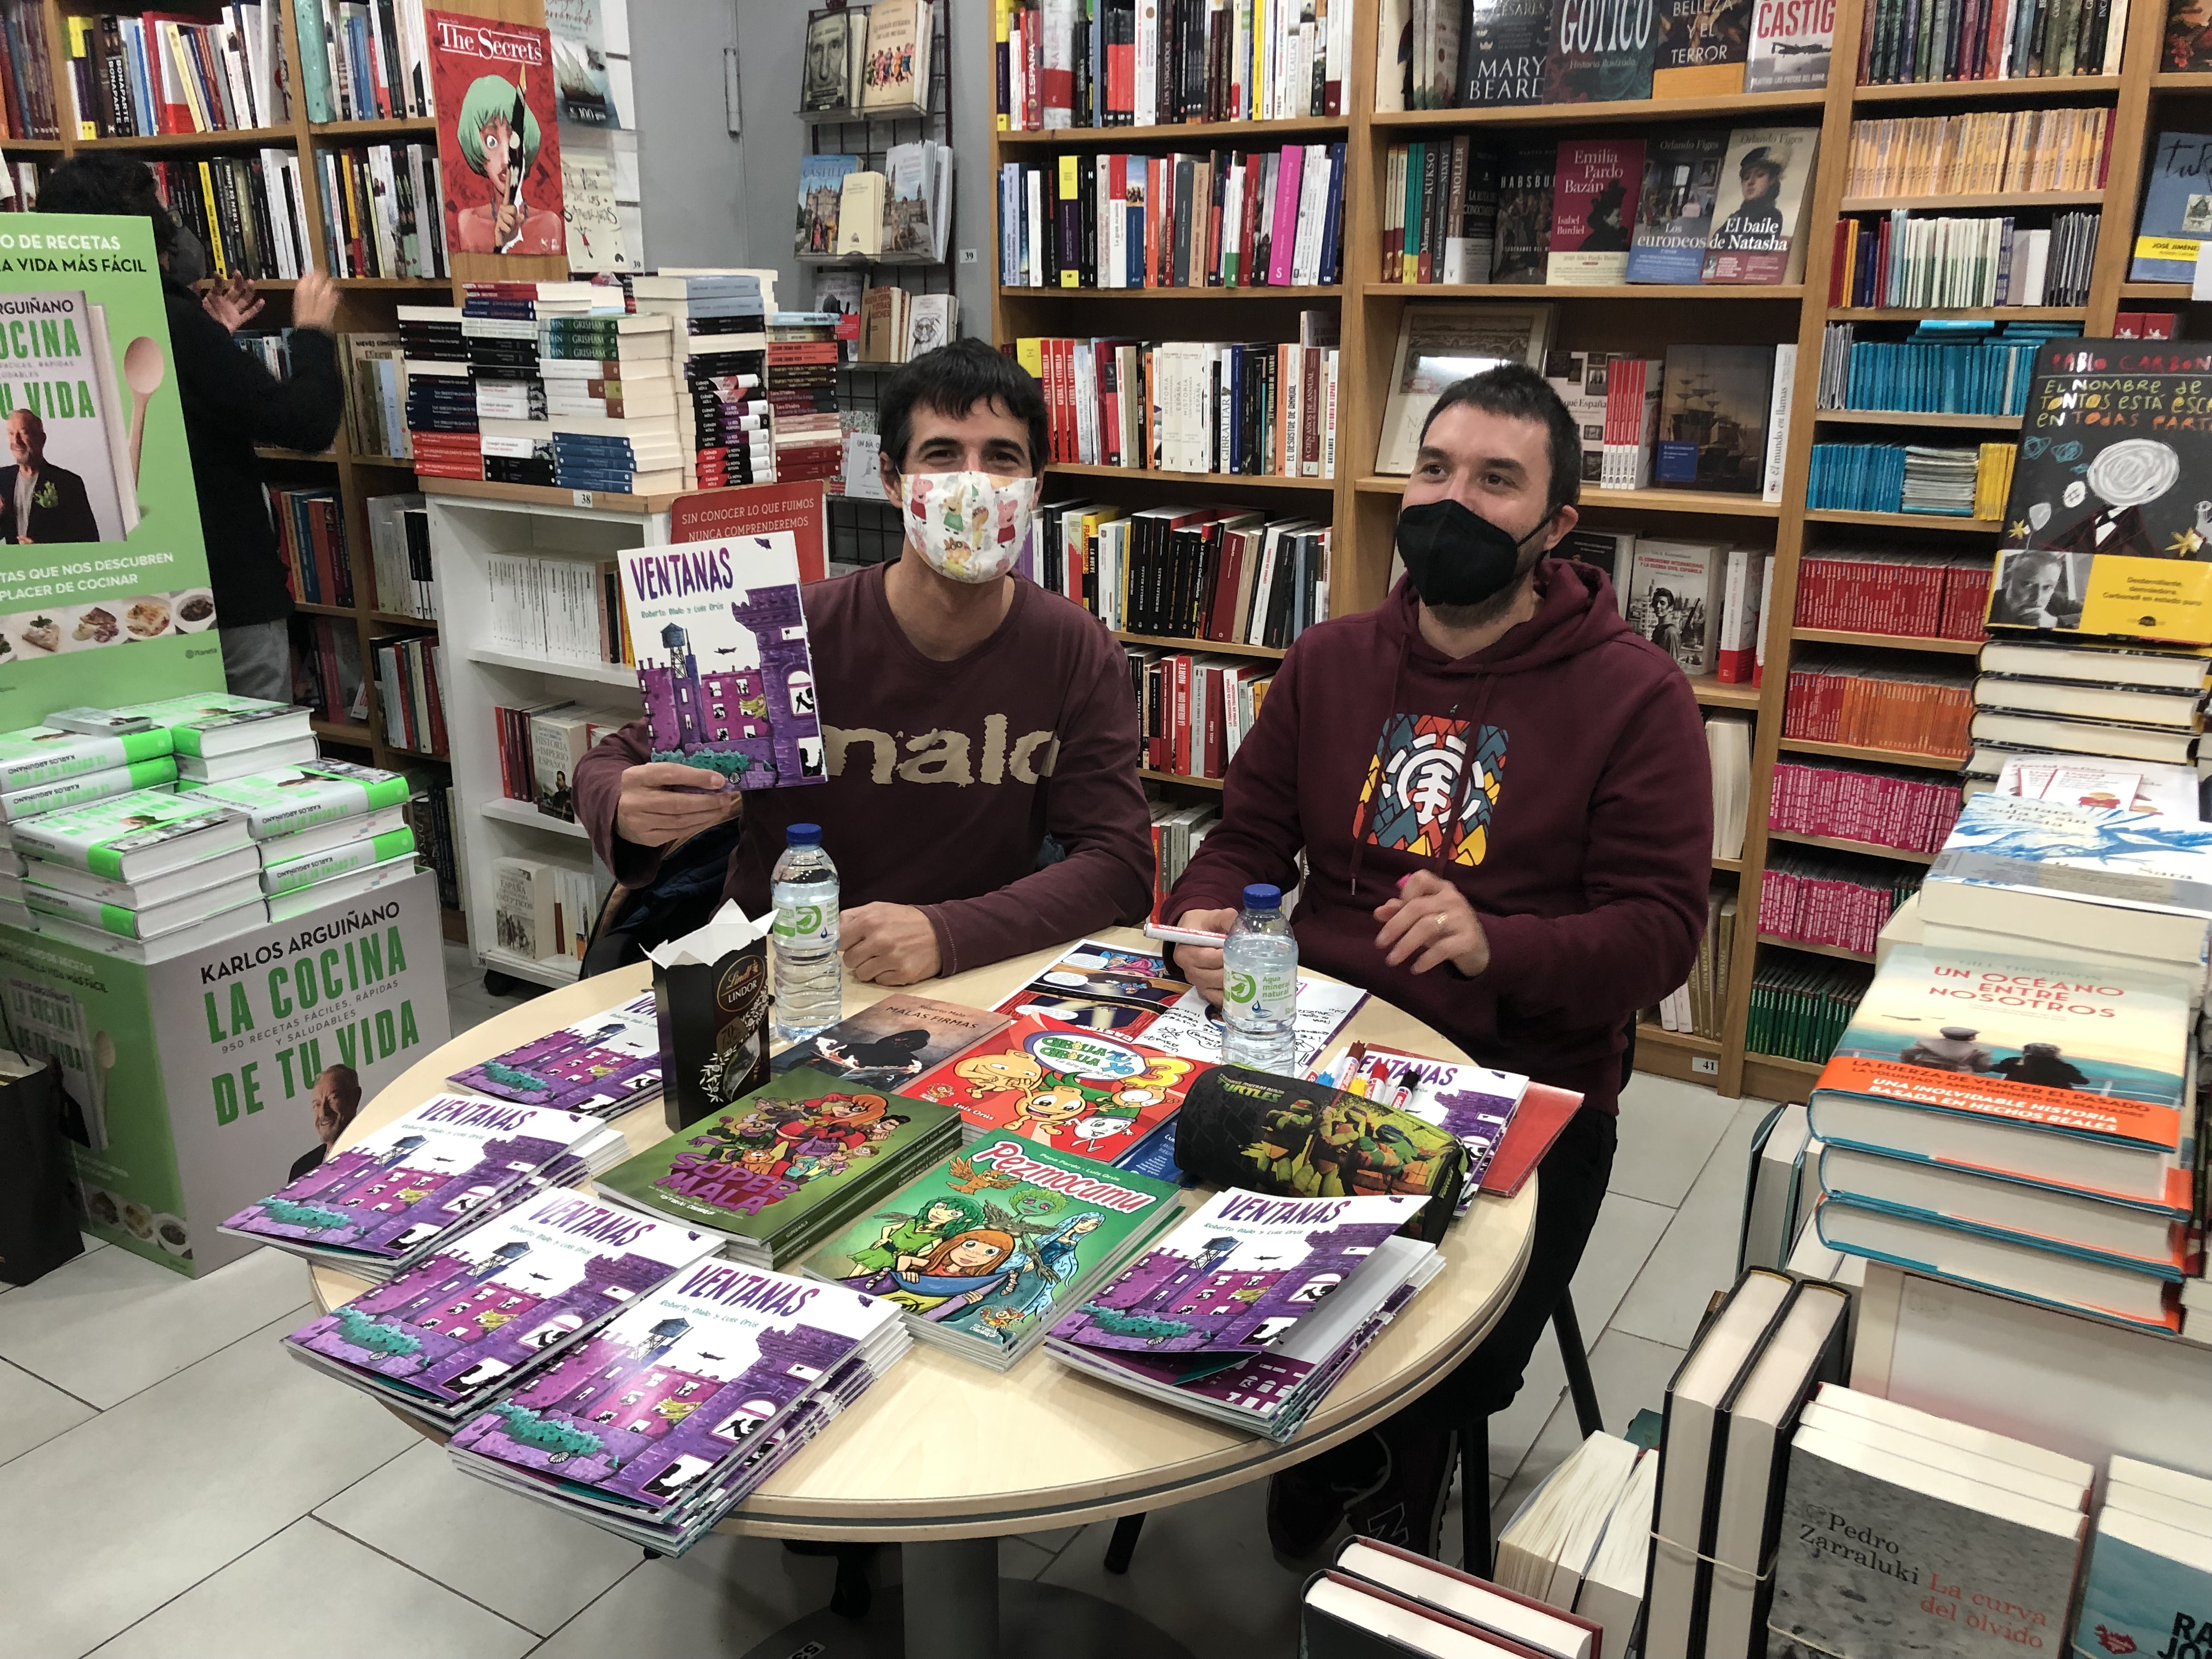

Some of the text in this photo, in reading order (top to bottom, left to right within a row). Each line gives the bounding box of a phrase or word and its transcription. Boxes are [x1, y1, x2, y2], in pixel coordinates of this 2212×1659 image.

[438, 22, 543, 60] The Secrets
[1700, 23, 1715, 37] EL
[1671, 45, 1727, 65] TERROR
[1478, 56, 1547, 78] MARY
[116, 60, 131, 123] BONAPARTE
[1575, 149, 1618, 165] Emilia
[1425, 152, 1435, 195] KUKSO
[1584, 165, 1624, 180] Pardo
[1565, 178, 1604, 194] Bazán
[1557, 215, 1580, 225] Isabel
[1557, 226, 1584, 236] Burdiel
[1665, 222, 1683, 234] Los
[1725, 216, 1779, 233] El baile
[20, 236, 121, 250] DE RECETAS
[1637, 235, 1707, 250] europeos
[1709, 233, 1788, 251] de Natasha
[17, 254, 147, 273] VIDA MÁS FÁCIL
[573, 320, 605, 329] GRISHAM
[572, 335, 604, 343] GRISHAM
[573, 348, 605, 357] GRISHAM
[27, 381, 95, 419] VIDA
[1579, 398, 1606, 408] España
[1776, 387, 1787, 415] llamas
[1771, 431, 1782, 461] mundo
[1770, 463, 1779, 476] El
[582, 494, 591, 504] 38
[681, 498, 815, 525] SIN CONOCER LO QUE FUIMOS
[688, 516, 809, 543] NUNCA COMPRENDEREMOS
[29, 552, 173, 580] QUE NOS DESCUBREN
[630, 547, 733, 602] VENTANAS
[57, 580, 74, 595] DE
[77, 574, 138, 591] COCINAR
[535, 736, 568, 752] HISTORIA
[541, 748, 568, 761] IMPERIO
[500, 881, 526, 894] ESPAÑA
[200, 901, 400, 985] KARLOS ARGUIÑANO
[204, 925, 408, 1044] LA COCINA
[727, 966, 752, 990] Lindt
[1262, 981, 1290, 991] mineral
[1934, 966, 2124, 996] UN OCÉANO
[727, 979, 758, 1005] LINDOR
[1262, 988, 1289, 998] natural
[1929, 988, 2115, 1017] NOSOTROS
[1978, 983, 2069, 1001] ENTRE
[221, 1039, 245, 1054] 950
[249, 1019, 300, 1045] RECETAS
[354, 979, 400, 1005] RÁPIDAS
[885, 1005, 980, 1030] MALAS FIRMAS
[918, 1004, 947, 1014] Roberto
[275, 1008, 357, 1046] Y SALUDABLES
[1076, 1025, 1133, 1041] CASTING
[1040, 1047, 1101, 1066] CEBOLLA
[1041, 1036, 1107, 1057] CEBOLLA
[211, 999, 421, 1127] DE TU VIDA
[1123, 1057, 1195, 1088] 3
[1702, 1061, 1715, 1071] 41
[1216, 1075, 1283, 1104] TURTLES
[1852, 1060, 2151, 1113] LA FUERZA DE VENCER EL PASADO
[953, 1102, 972, 1115] Luis
[1869, 1086, 2118, 1132] BASADA EN HECHOS REALES
[1871, 1077, 2118, 1124] UNA INOLVIDABLE HISTORIA
[417, 1098, 537, 1132] VENTANAS
[1040, 1153, 1057, 1162] Pepa
[1059, 1158, 1081, 1170] Pardo
[669, 1152, 801, 1201] SUPER
[973, 1141, 1157, 1214] Pezmocamu
[654, 1171, 770, 1217] MALA
[1217, 1194, 1352, 1225] VENTANAS
[528, 1196, 656, 1247] VENTANAS
[1204, 1222, 1234, 1233] Roberto
[676, 1264, 820, 1317] VENTANAS
[659, 1300, 690, 1313] Roberto
[1827, 1510, 1901, 1556] Pedro
[1798, 1523, 1921, 1587] Zarraluki
[1929, 1572, 2048, 1628] La curva
[1920, 1595, 2045, 1651] del olvido
